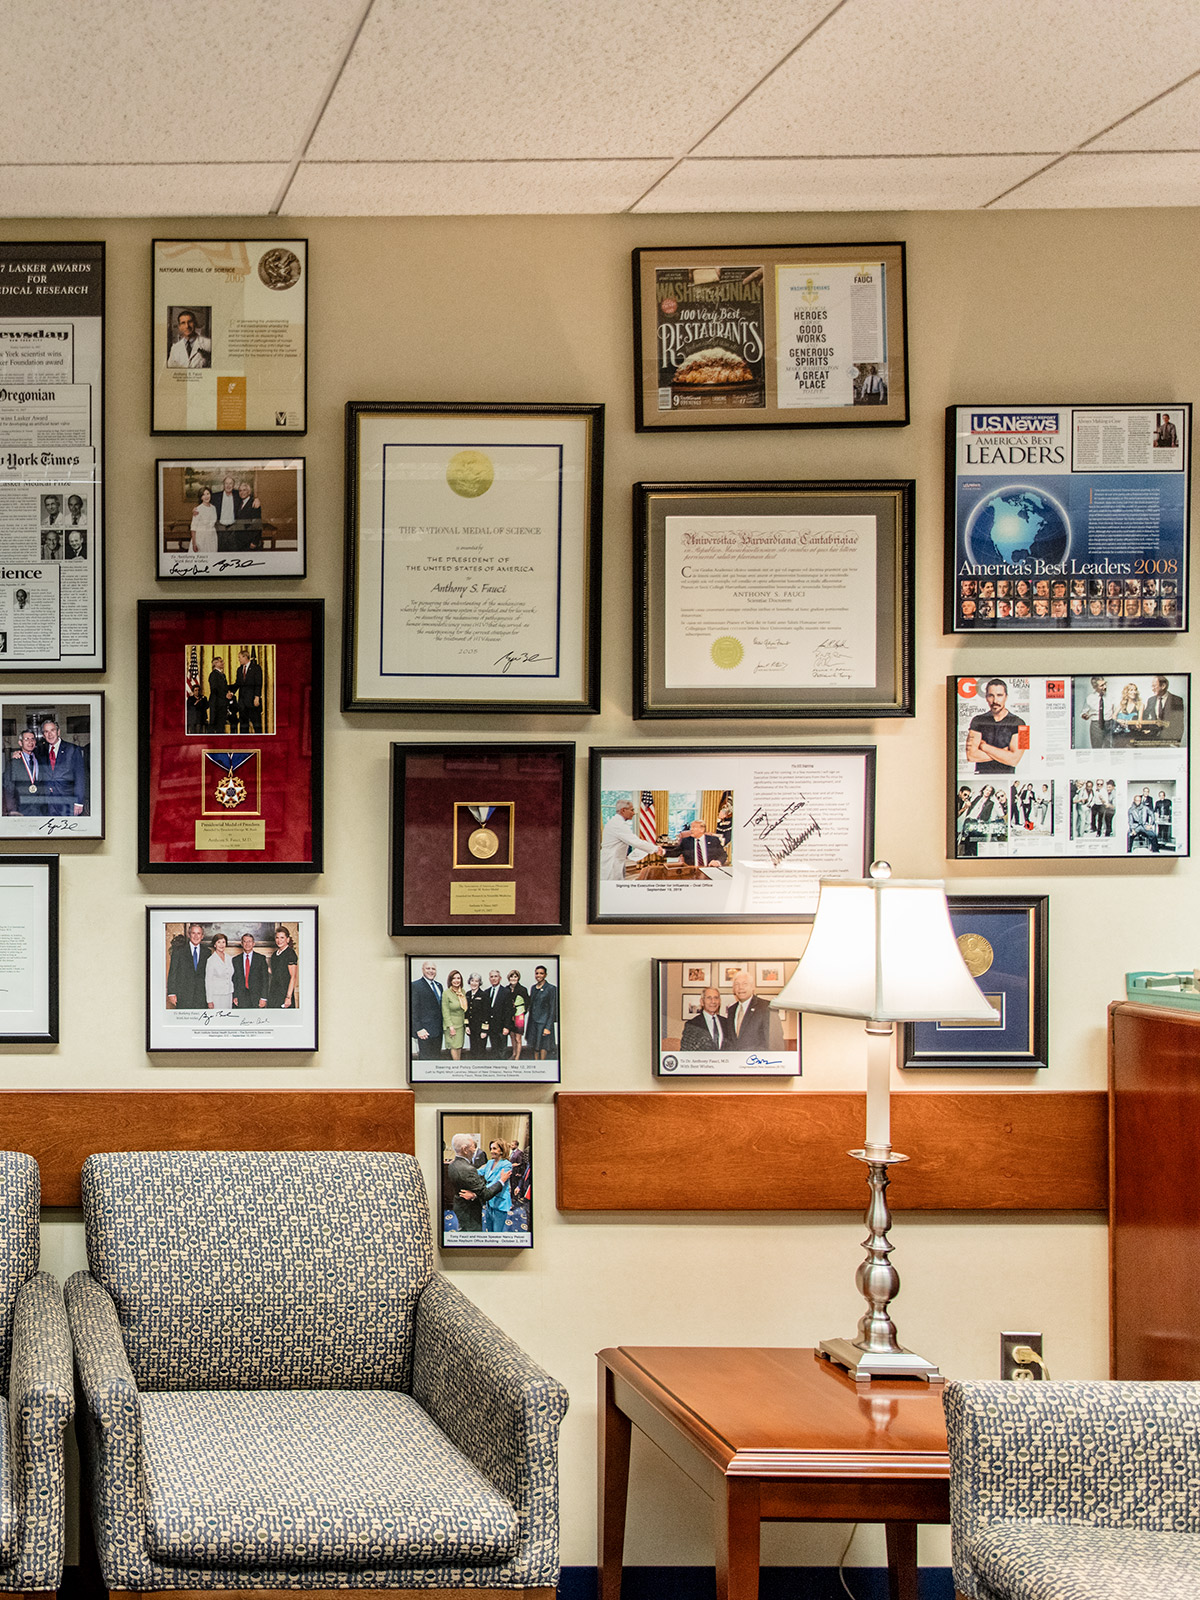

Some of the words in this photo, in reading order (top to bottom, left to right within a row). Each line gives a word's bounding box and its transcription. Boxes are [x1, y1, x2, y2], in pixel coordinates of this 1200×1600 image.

[9, 264, 46, 272] LASKER
[50, 264, 91, 272] AWARDS
[27, 275, 47, 283] FOR
[36, 286, 88, 294] RESEARCH
[680, 310, 696, 321] 100
[697, 309, 720, 323] Very
[720, 308, 740, 319] Best
[794, 311, 827, 320] HEROES
[800, 325, 823, 333] GOOD
[796, 334, 826, 343] WORKS
[657, 320, 763, 368] RESTAURANTS
[789, 348, 834, 357] GENEROUS
[795, 358, 828, 366] SPIRITS
[795, 371, 800, 379] A
[803, 371, 829, 379] GREAT
[800, 380, 826, 389] PLACE
[1031, 436, 1053, 444] BEST
[967, 445, 1064, 464] LEADERS
[7, 453, 38, 470] York
[41, 453, 80, 466] Times
[399, 526, 417, 535] THE
[419, 526, 460, 535] NATIONAL
[463, 527, 492, 535] MEDAL
[494, 527, 504, 535] OF
[682, 531, 737, 545] Universitas
[739, 531, 797, 546] Harvardiana
[800, 531, 859, 545] Cantabrigiae
[1035, 559, 1067, 576] Best
[1071, 558, 1130, 575] Leaders
[1134, 559, 1177, 575] 2008
[431, 582, 469, 598] Anthony
[470, 584, 479, 593] S.
[482, 584, 507, 593] Fauci
